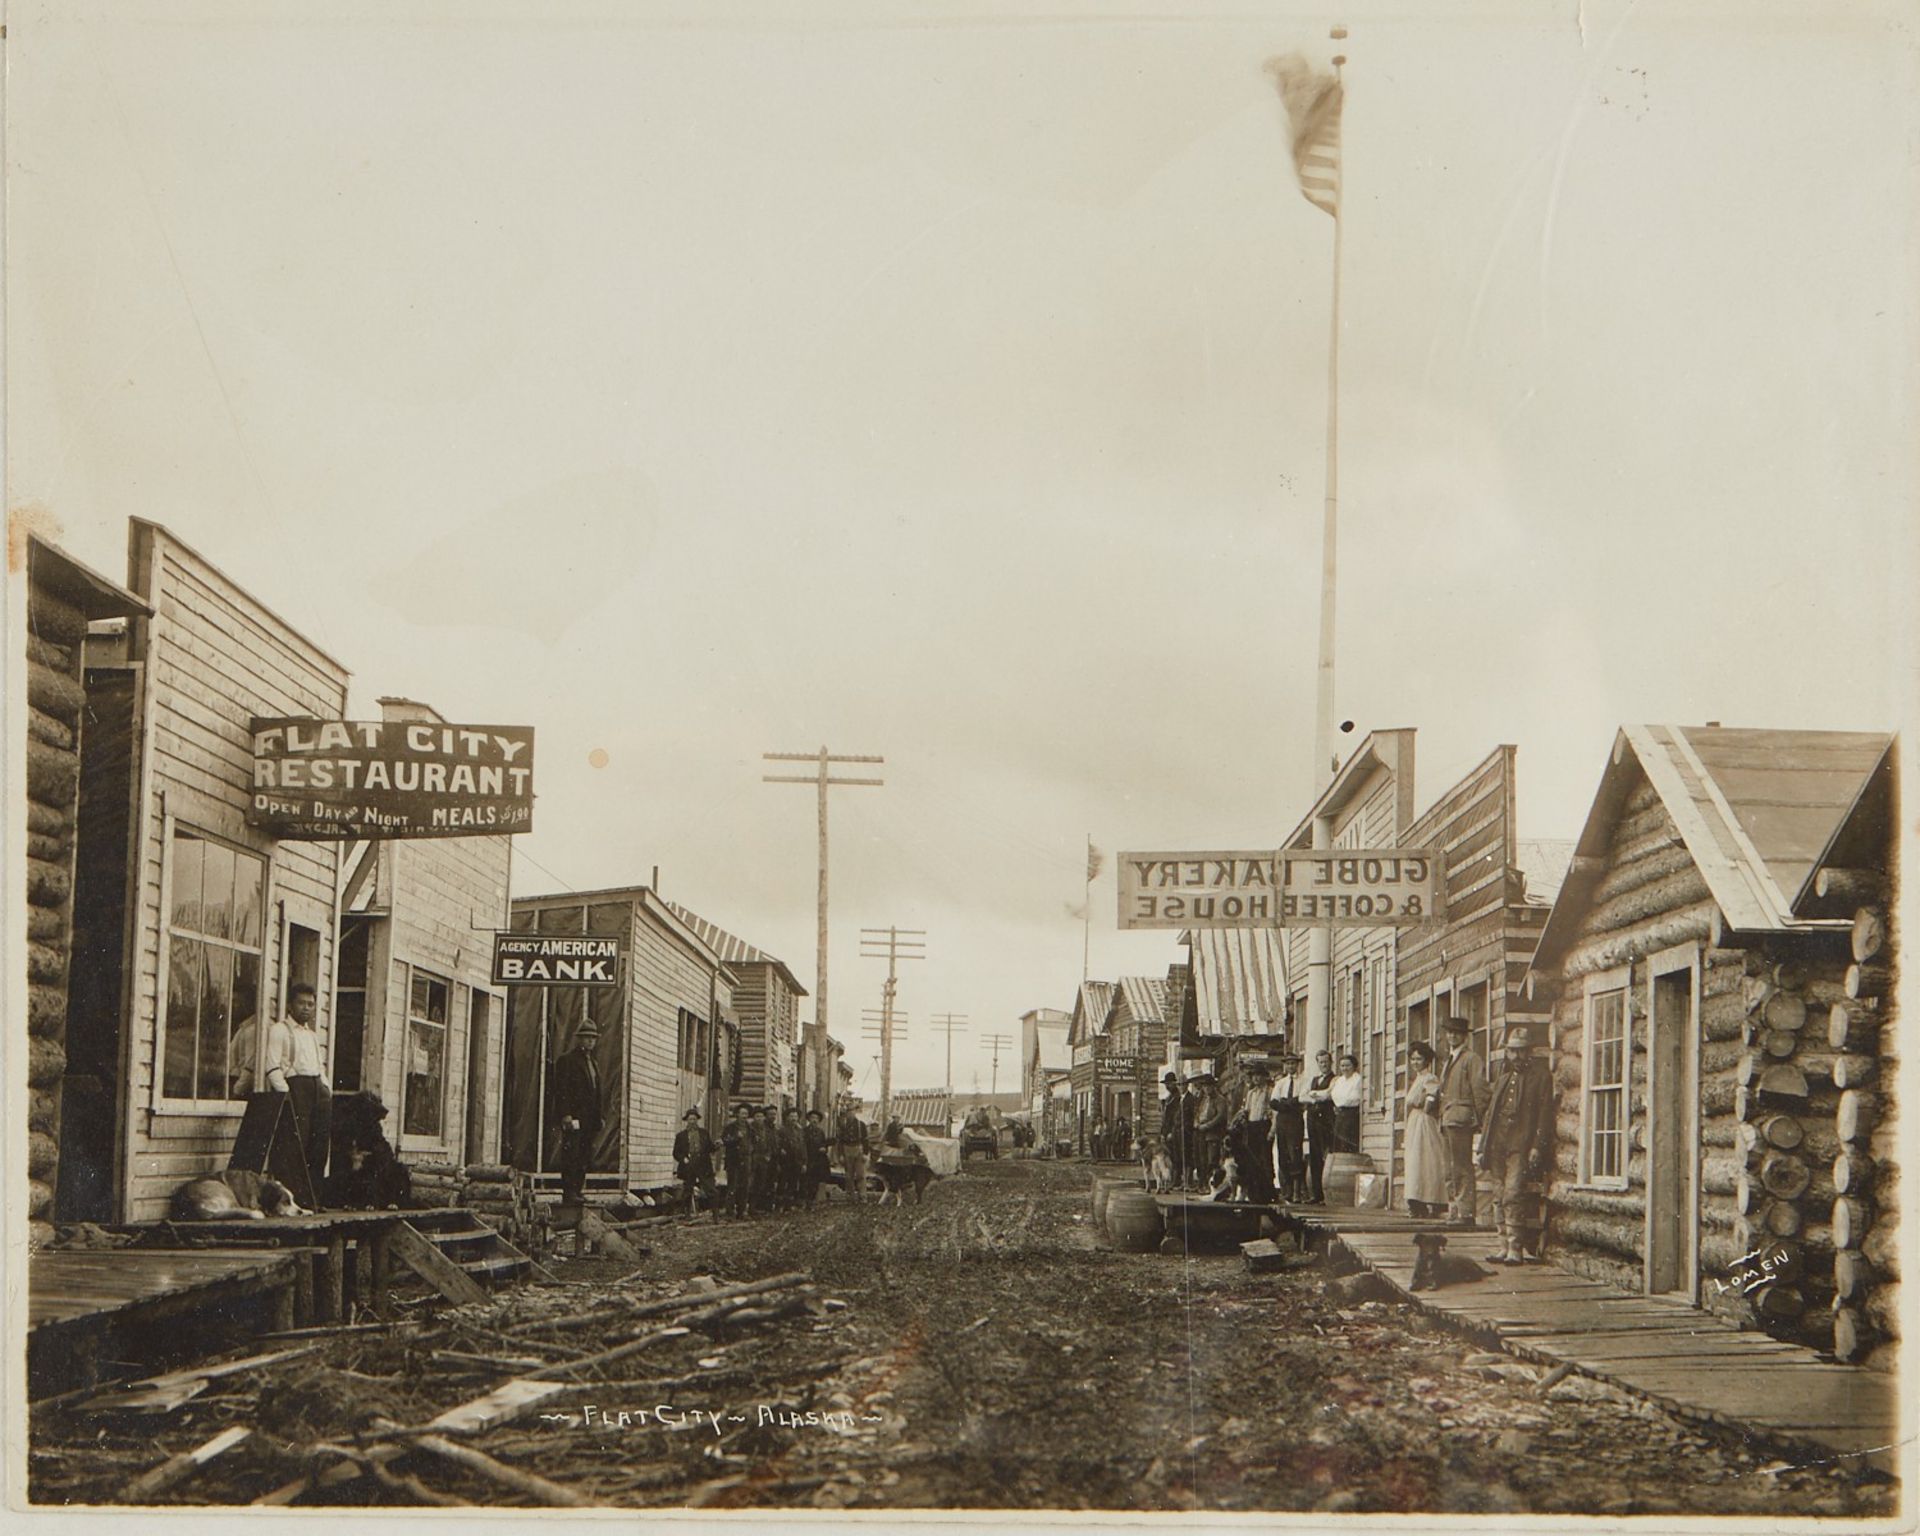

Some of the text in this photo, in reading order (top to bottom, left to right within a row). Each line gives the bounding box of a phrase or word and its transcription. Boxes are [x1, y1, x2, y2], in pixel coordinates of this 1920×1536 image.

[255, 722, 526, 761] FLAT CITY
[254, 759, 531, 796] RESTAURANT
[254, 795, 301, 816] OPEN
[313, 801, 346, 820] DAY
[363, 806, 409, 826] NIGHT
[432, 806, 496, 826] MEALS
[500, 940, 616, 957] AGENCY AMERICAN
[502, 958, 613, 980] BANK.
[1104, 1058, 1134, 1069] HOME
